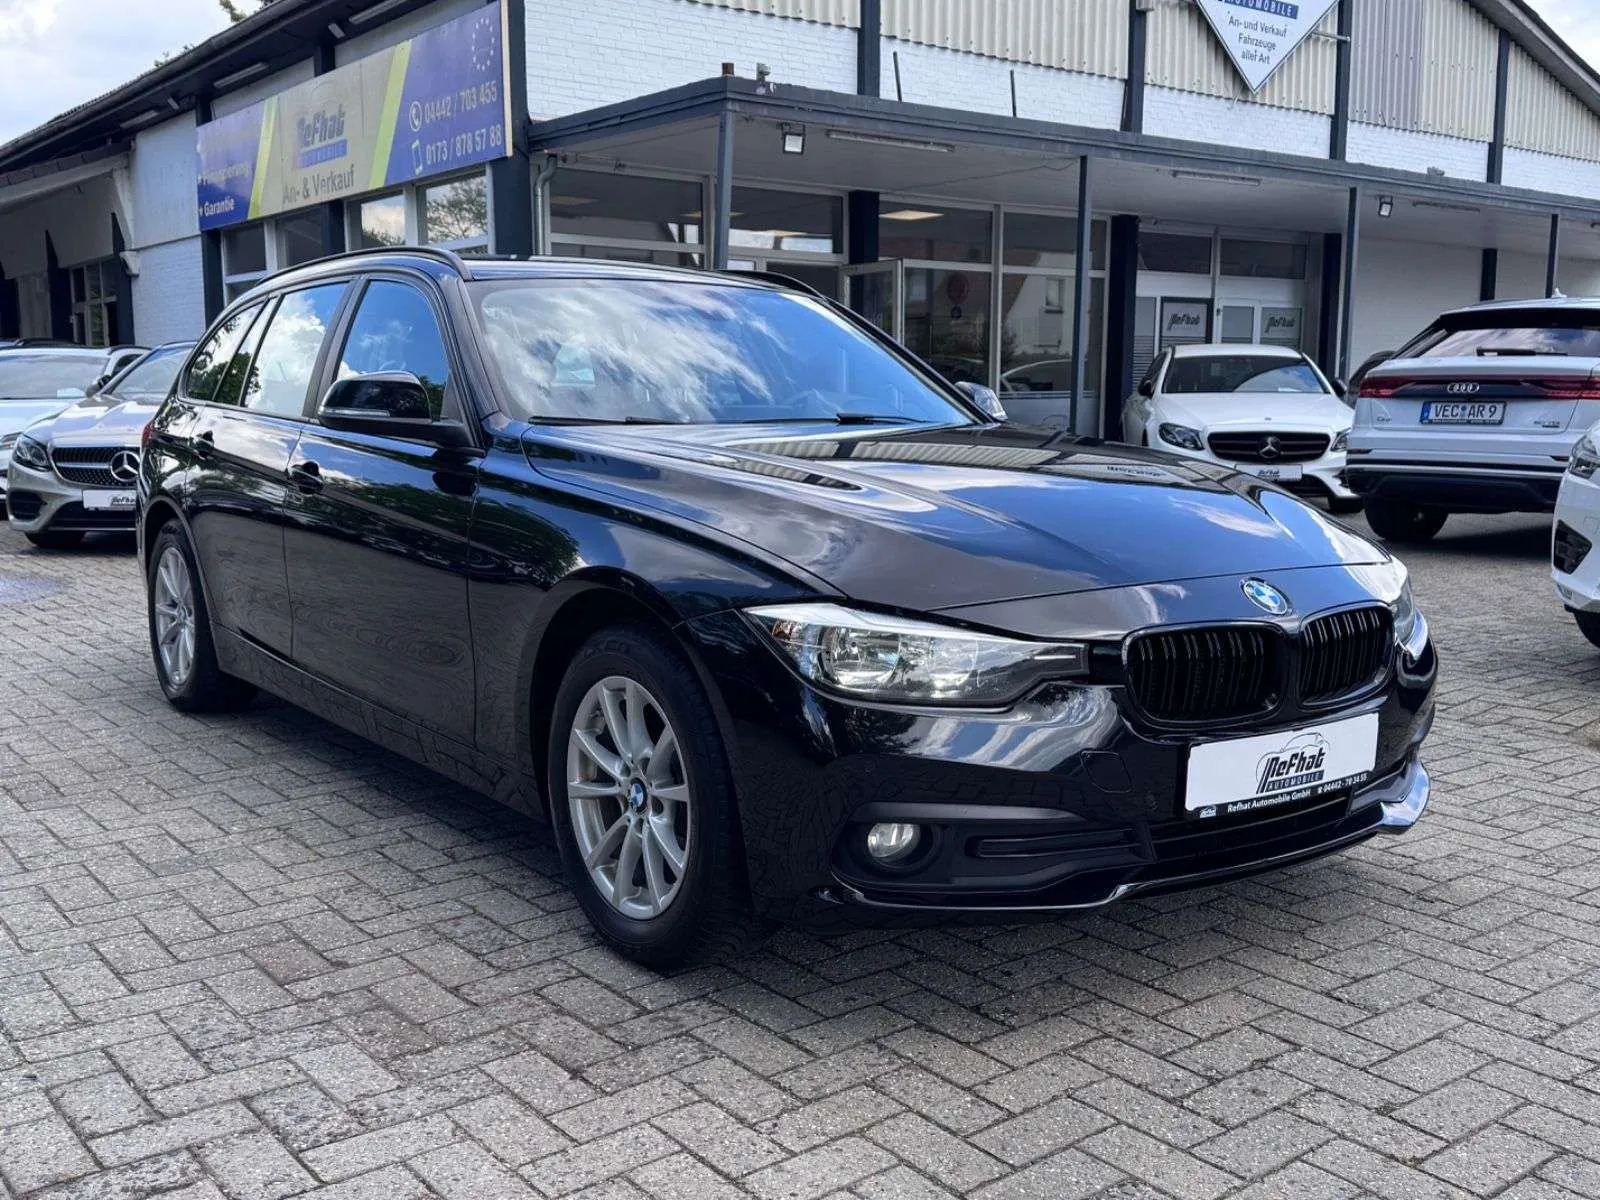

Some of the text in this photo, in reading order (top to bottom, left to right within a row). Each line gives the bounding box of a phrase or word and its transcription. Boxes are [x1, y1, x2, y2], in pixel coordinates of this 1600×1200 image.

[1225, 0, 1291, 16] TOMOBILE
[1228, 16, 1287, 38] An- und Verkauf
[1238, 33, 1276, 52] Fahrzeuge
[1241, 49, 1271, 64] aller Art
[424, 96, 452, 124] 04442
[460, 87, 478, 112] 703
[480, 80, 497, 104] 455
[426, 140, 448, 165] 0173
[456, 132, 473, 157] 878
[475, 128, 486, 152] 57
[490, 124, 502, 147] 88
[281, 163, 355, 204] An- & Verkauf
[204, 196, 235, 217] Garantie
[1434, 403, 1498, 419] VEC AR 9
[1267, 772, 1320, 790] AUTOMOBILE
[1227, 802, 1251, 813] Refhat
[1251, 795, 1291, 809] Automobile
[1291, 789, 1311, 800] GmbH
